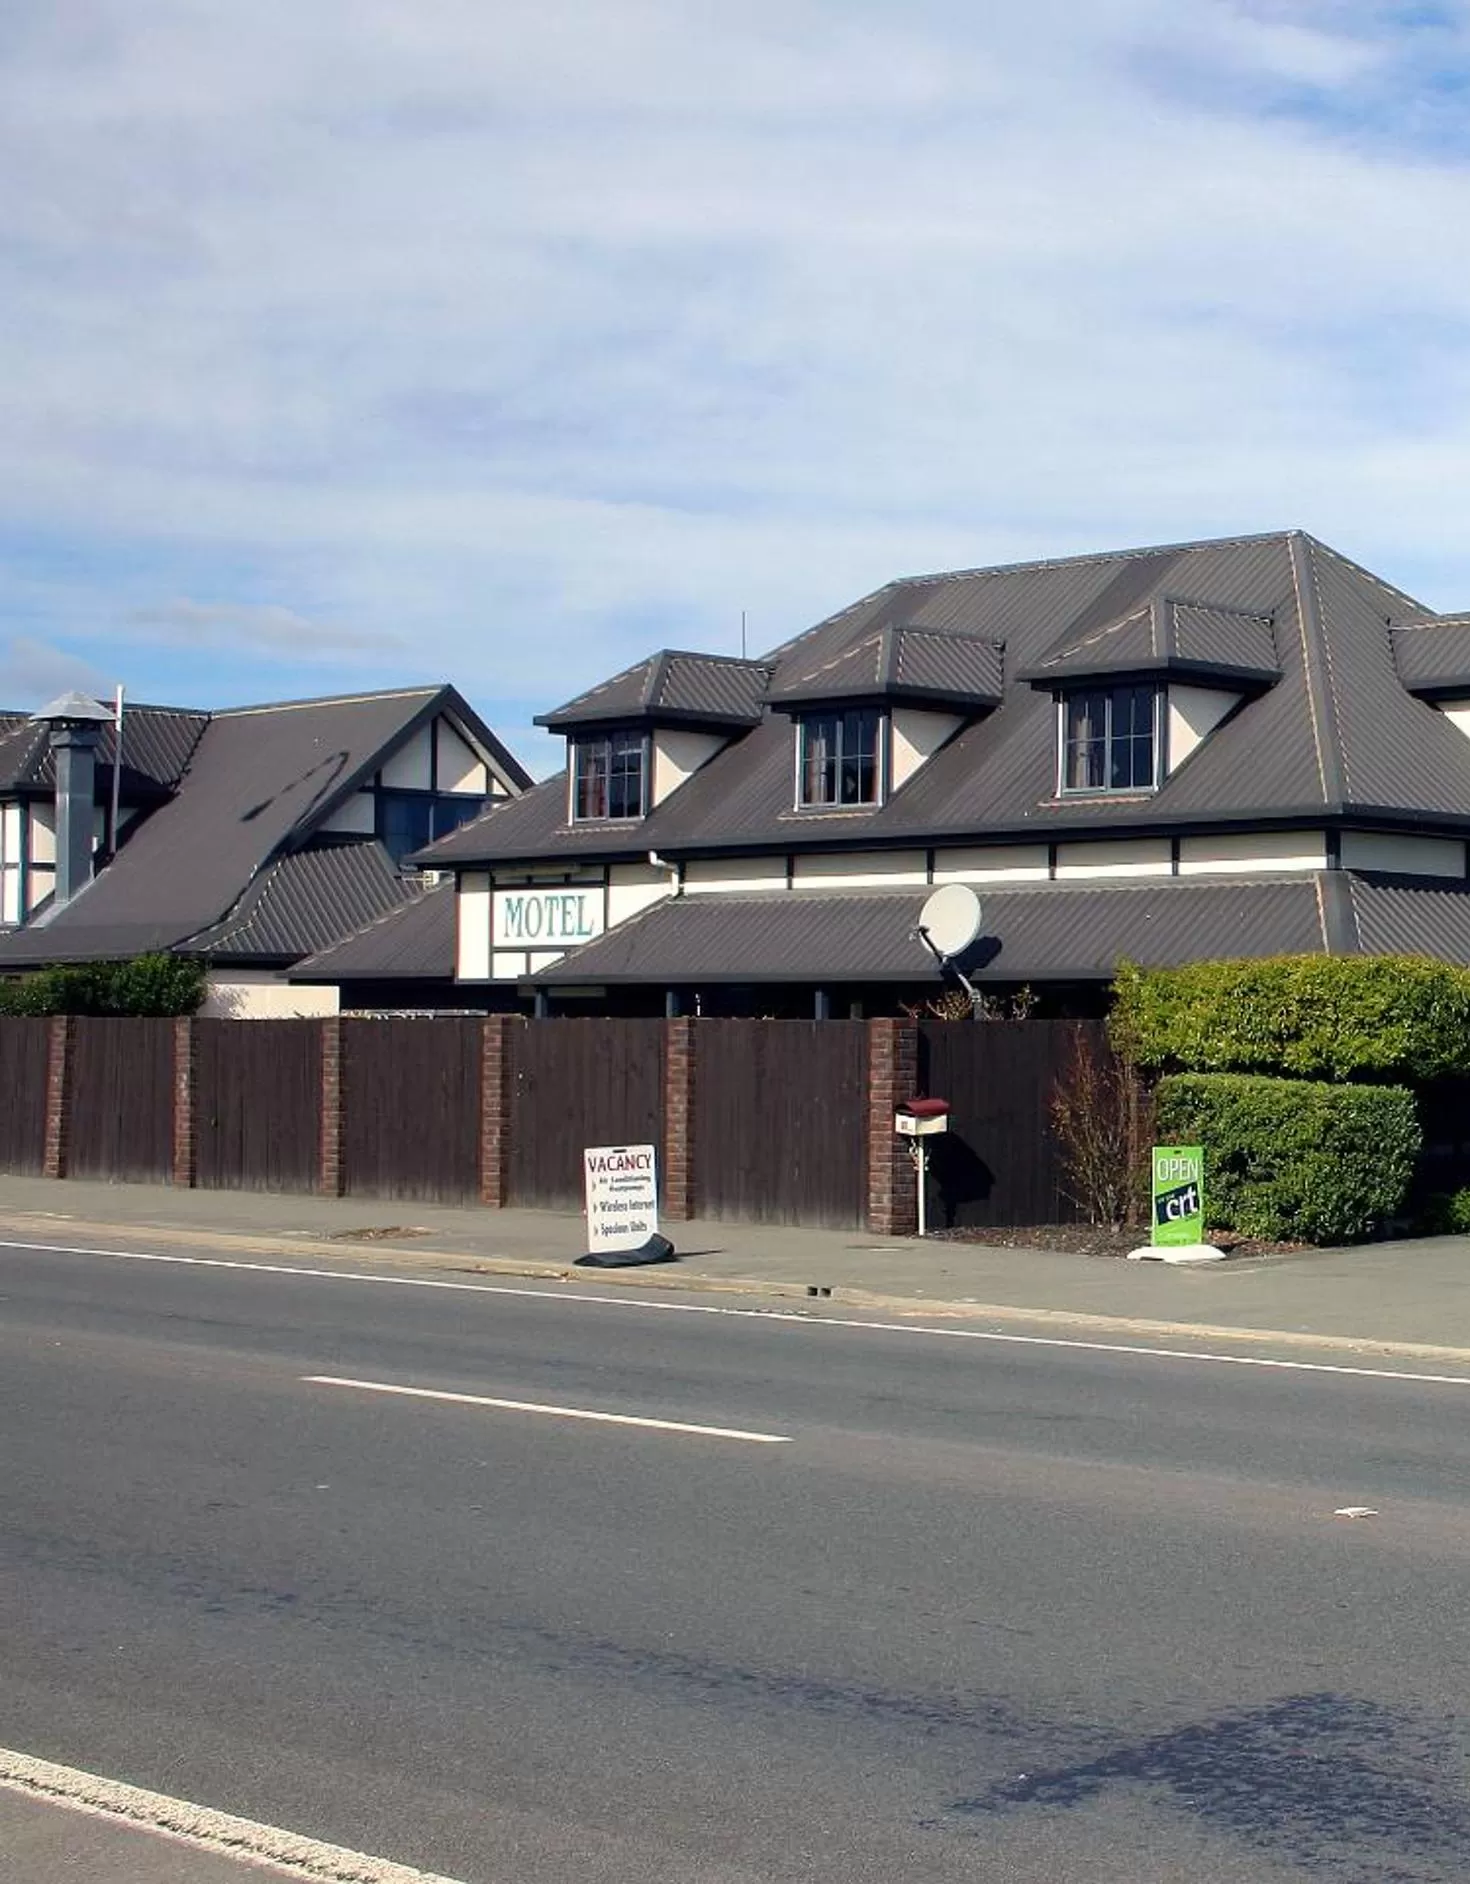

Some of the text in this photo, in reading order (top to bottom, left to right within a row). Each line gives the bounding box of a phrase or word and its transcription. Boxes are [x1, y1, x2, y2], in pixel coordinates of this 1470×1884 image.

[504, 895, 594, 937] MOTEL
[588, 1154, 651, 1172] VACANCY
[1157, 1158, 1199, 1181] OPEN
[1166, 1187, 1198, 1220] crt
